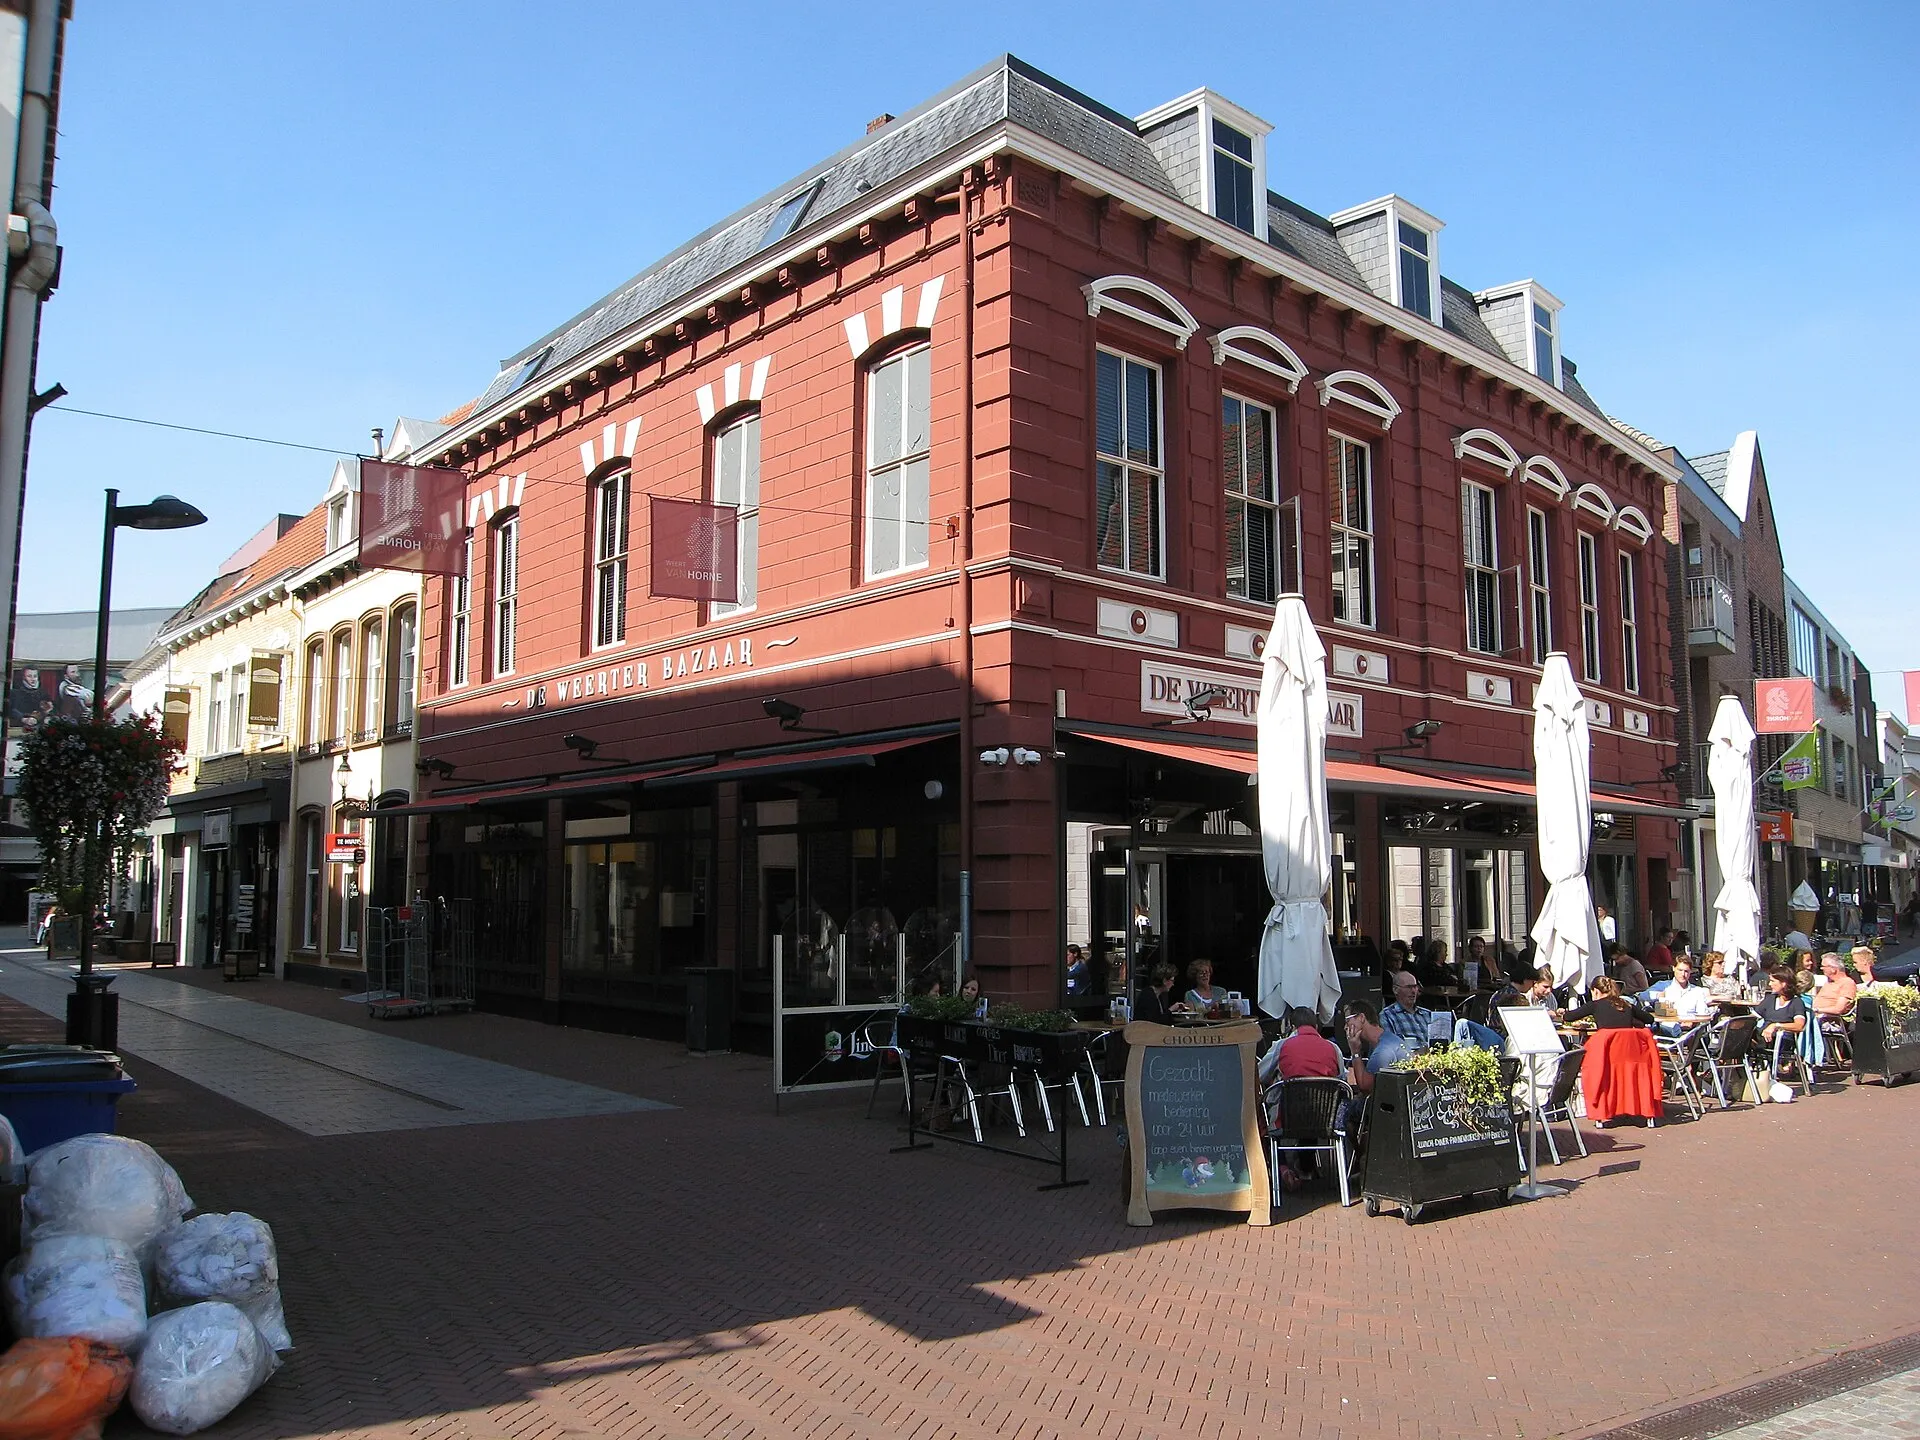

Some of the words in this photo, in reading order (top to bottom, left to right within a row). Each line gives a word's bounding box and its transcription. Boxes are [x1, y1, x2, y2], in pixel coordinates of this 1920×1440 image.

[687, 570, 723, 582] HORNE
[526, 686, 547, 709] DE
[556, 662, 649, 702] WEERTER
[661, 638, 754, 680] BAZAAR
[1150, 674, 1181, 703] DE
[1162, 1035, 1225, 1045] CHOUFFE
[1149, 1055, 1215, 1082] Gezocht
[1177, 1122, 1193, 1138] 24
